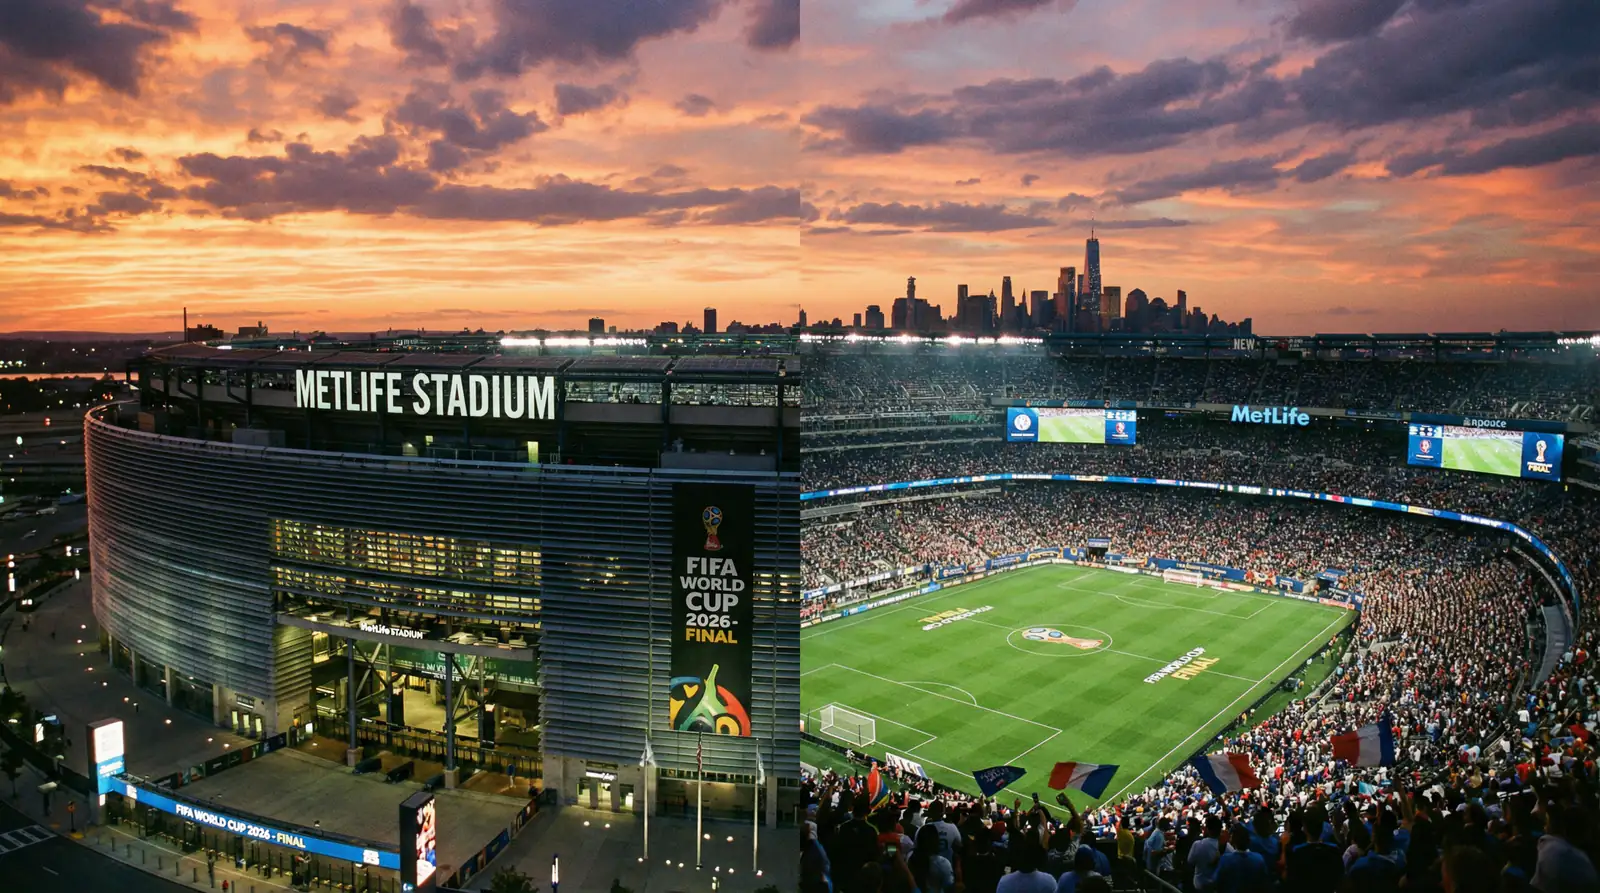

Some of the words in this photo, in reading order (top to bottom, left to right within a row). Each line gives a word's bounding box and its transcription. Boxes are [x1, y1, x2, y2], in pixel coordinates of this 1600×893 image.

[1233, 338, 1255, 350] NEW
[295, 369, 403, 414] METLIFE
[412, 372, 555, 420] STADIUM
[1230, 404, 1310, 426] MetLife
[686, 556, 738, 577] FIFA
[679, 576, 745, 592] WORLD
[685, 591, 739, 612] CUP
[686, 612, 738, 628] 2026-
[391, 627, 424, 640] STADIUM
[685, 628, 738, 644] FINAL
[1170, 657, 1220, 680] FINAL
[175, 804, 194, 819] FIFA
[194, 809, 226, 828] WORLD
[227, 819, 247, 833] CUP
[247, 825, 271, 840] 2026
[276, 832, 306, 849] FINAL
